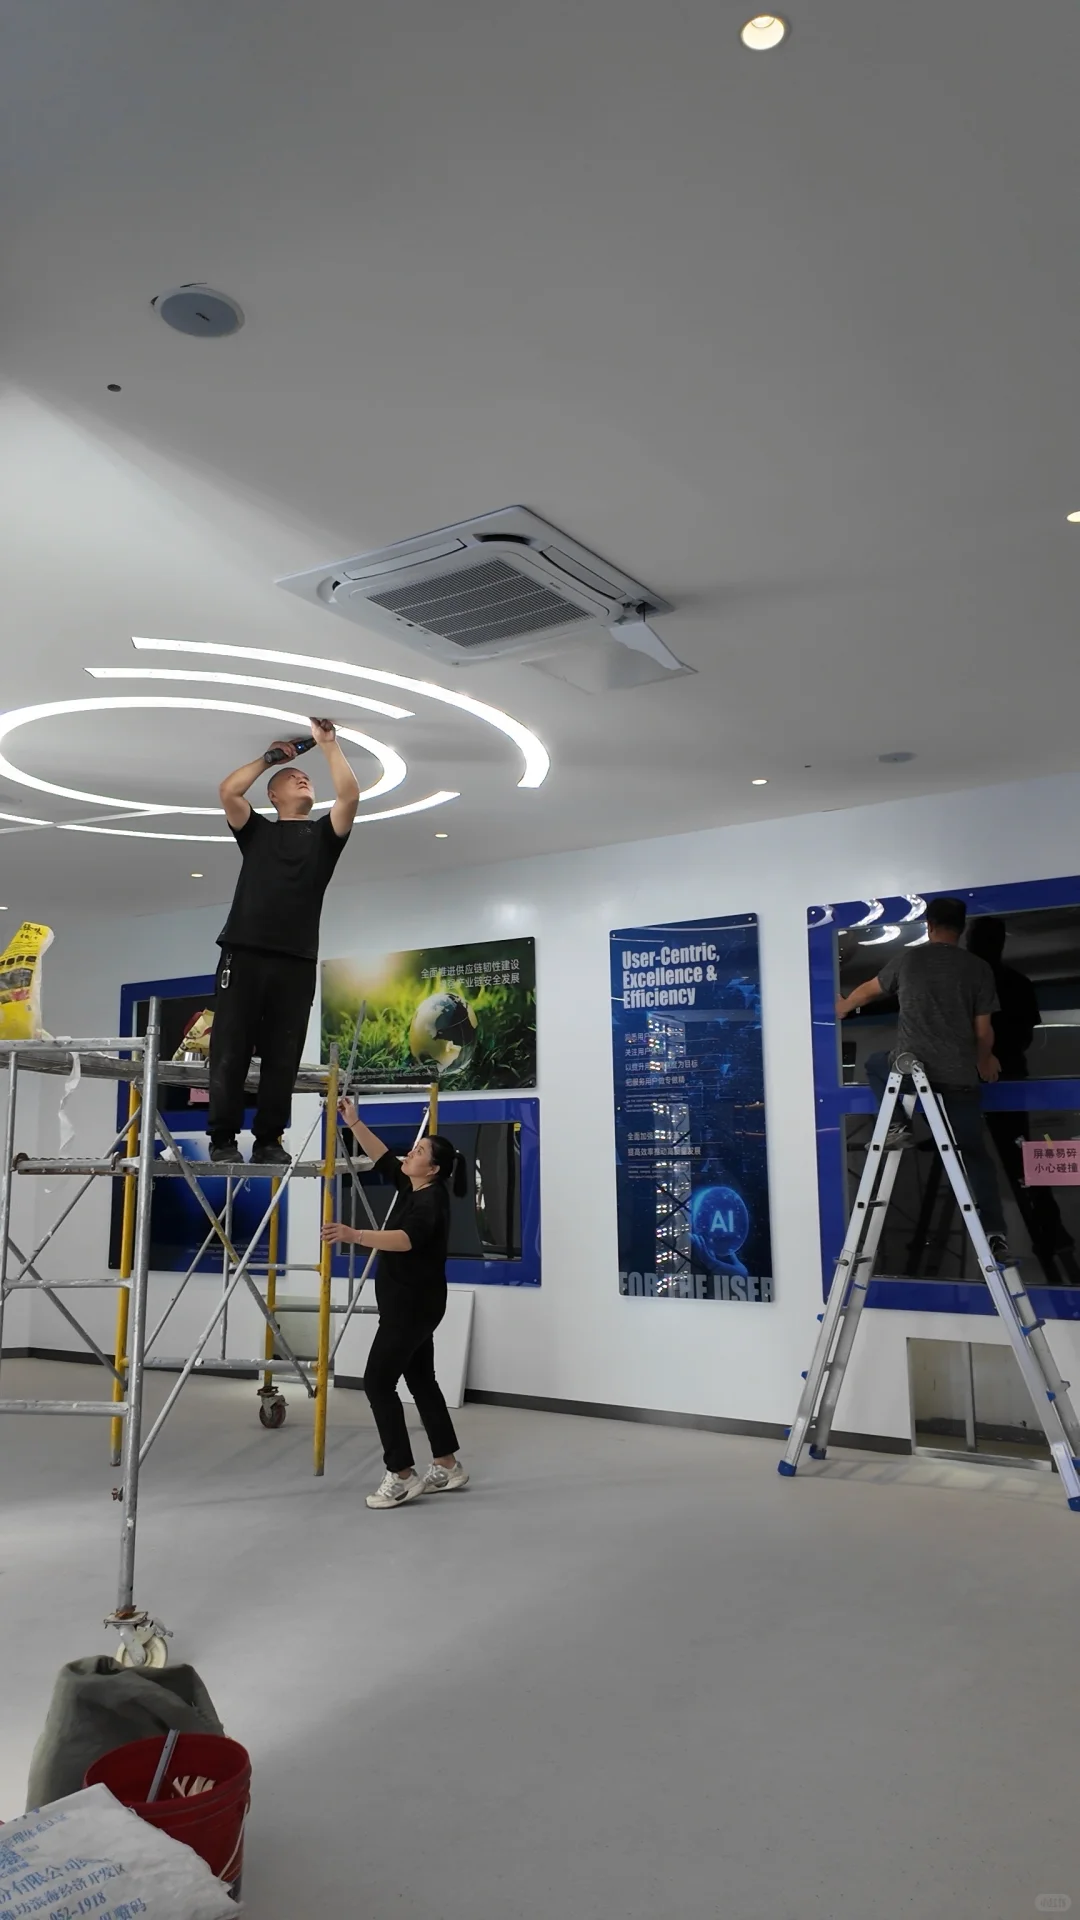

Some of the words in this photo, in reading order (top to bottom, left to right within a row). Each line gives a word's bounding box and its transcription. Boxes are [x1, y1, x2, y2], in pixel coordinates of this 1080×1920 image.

[622, 942, 720, 969] User-Centric,
[420, 958, 520, 979] 全面推进供应链韧性建设
[622, 966, 702, 989] Excellence
[706, 964, 718, 981] &
[440, 972, 520, 990] 强产业链安全发展
[623, 987, 696, 1009] Efficiency
[1033, 1148, 1077, 1159] 屏幕易碎
[1034, 1162, 1079, 1174] 小心碰撞
[710, 1210, 734, 1233] AI
